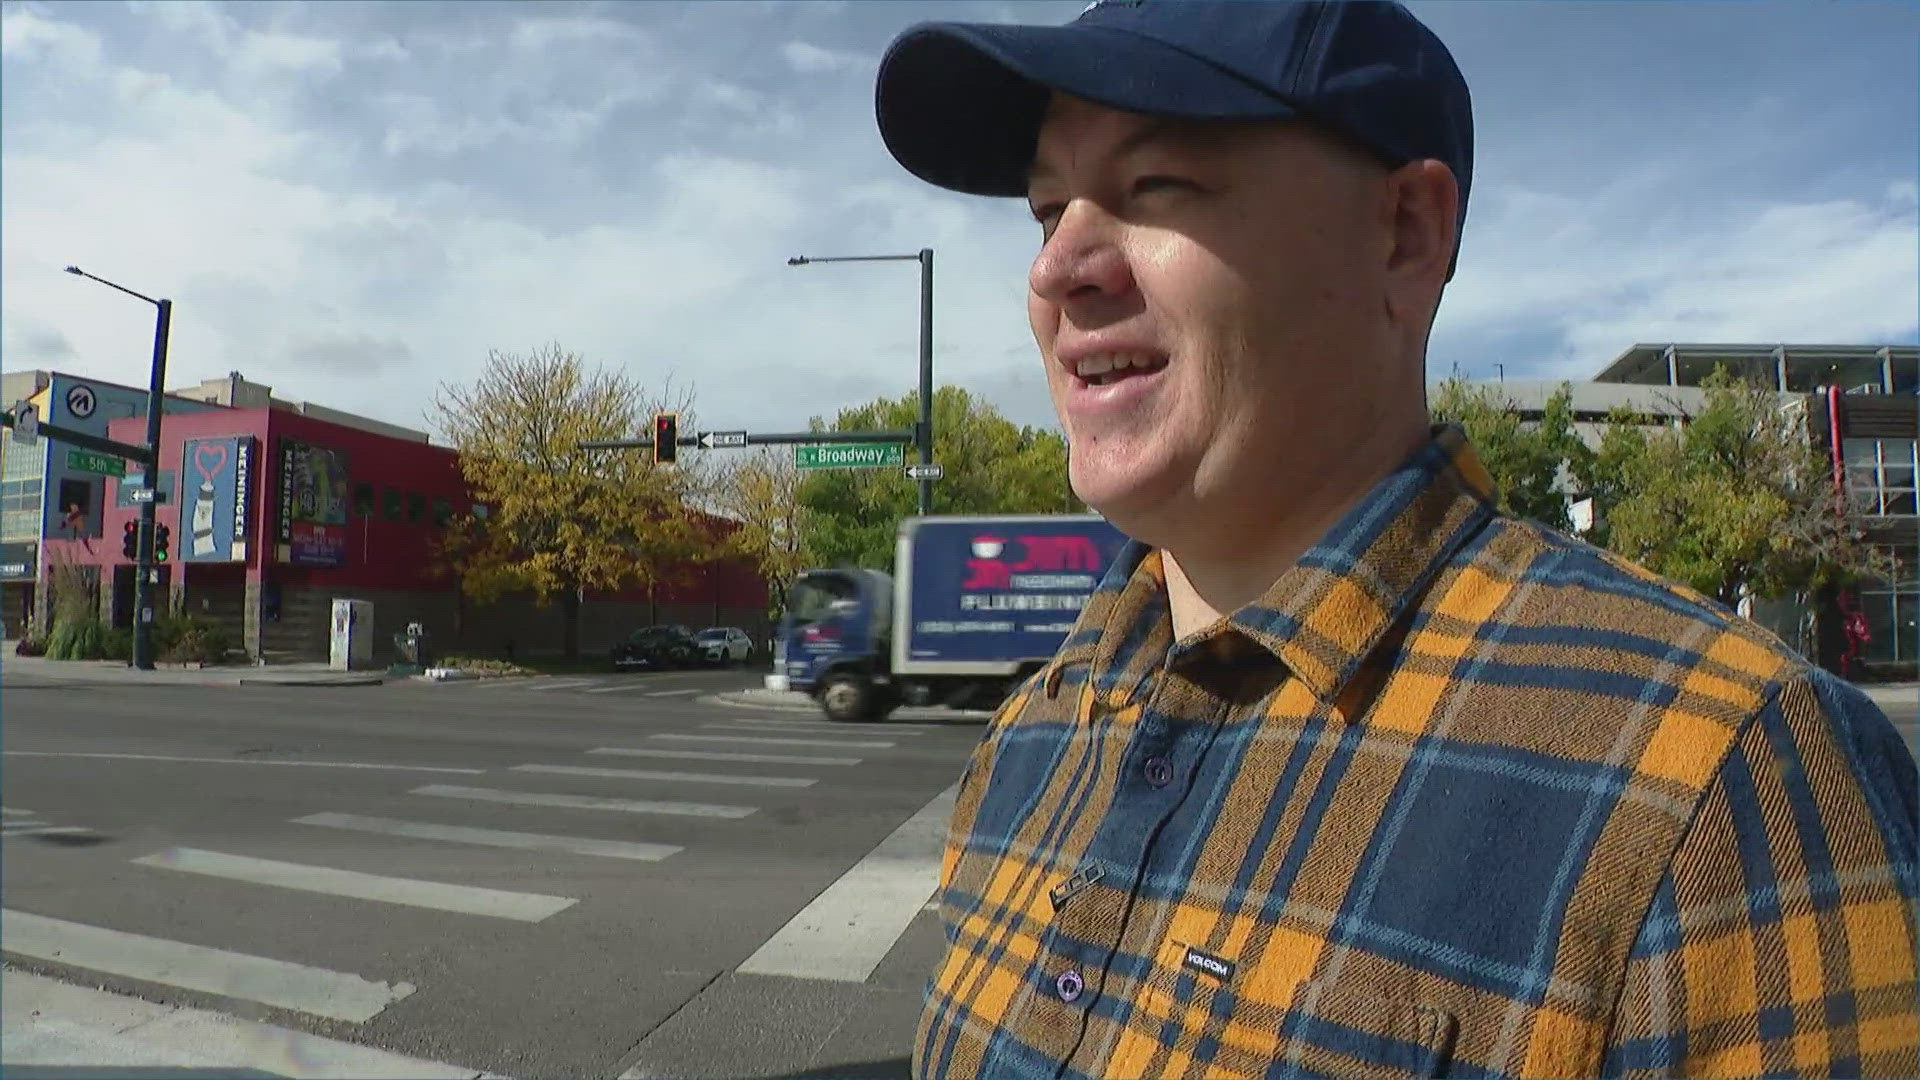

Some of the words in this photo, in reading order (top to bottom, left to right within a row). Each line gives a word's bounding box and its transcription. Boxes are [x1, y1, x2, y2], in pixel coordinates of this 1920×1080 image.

[89, 457, 107, 471] 5th
[818, 447, 884, 464] Broadway
[1188, 952, 1228, 976] VOLCOM
